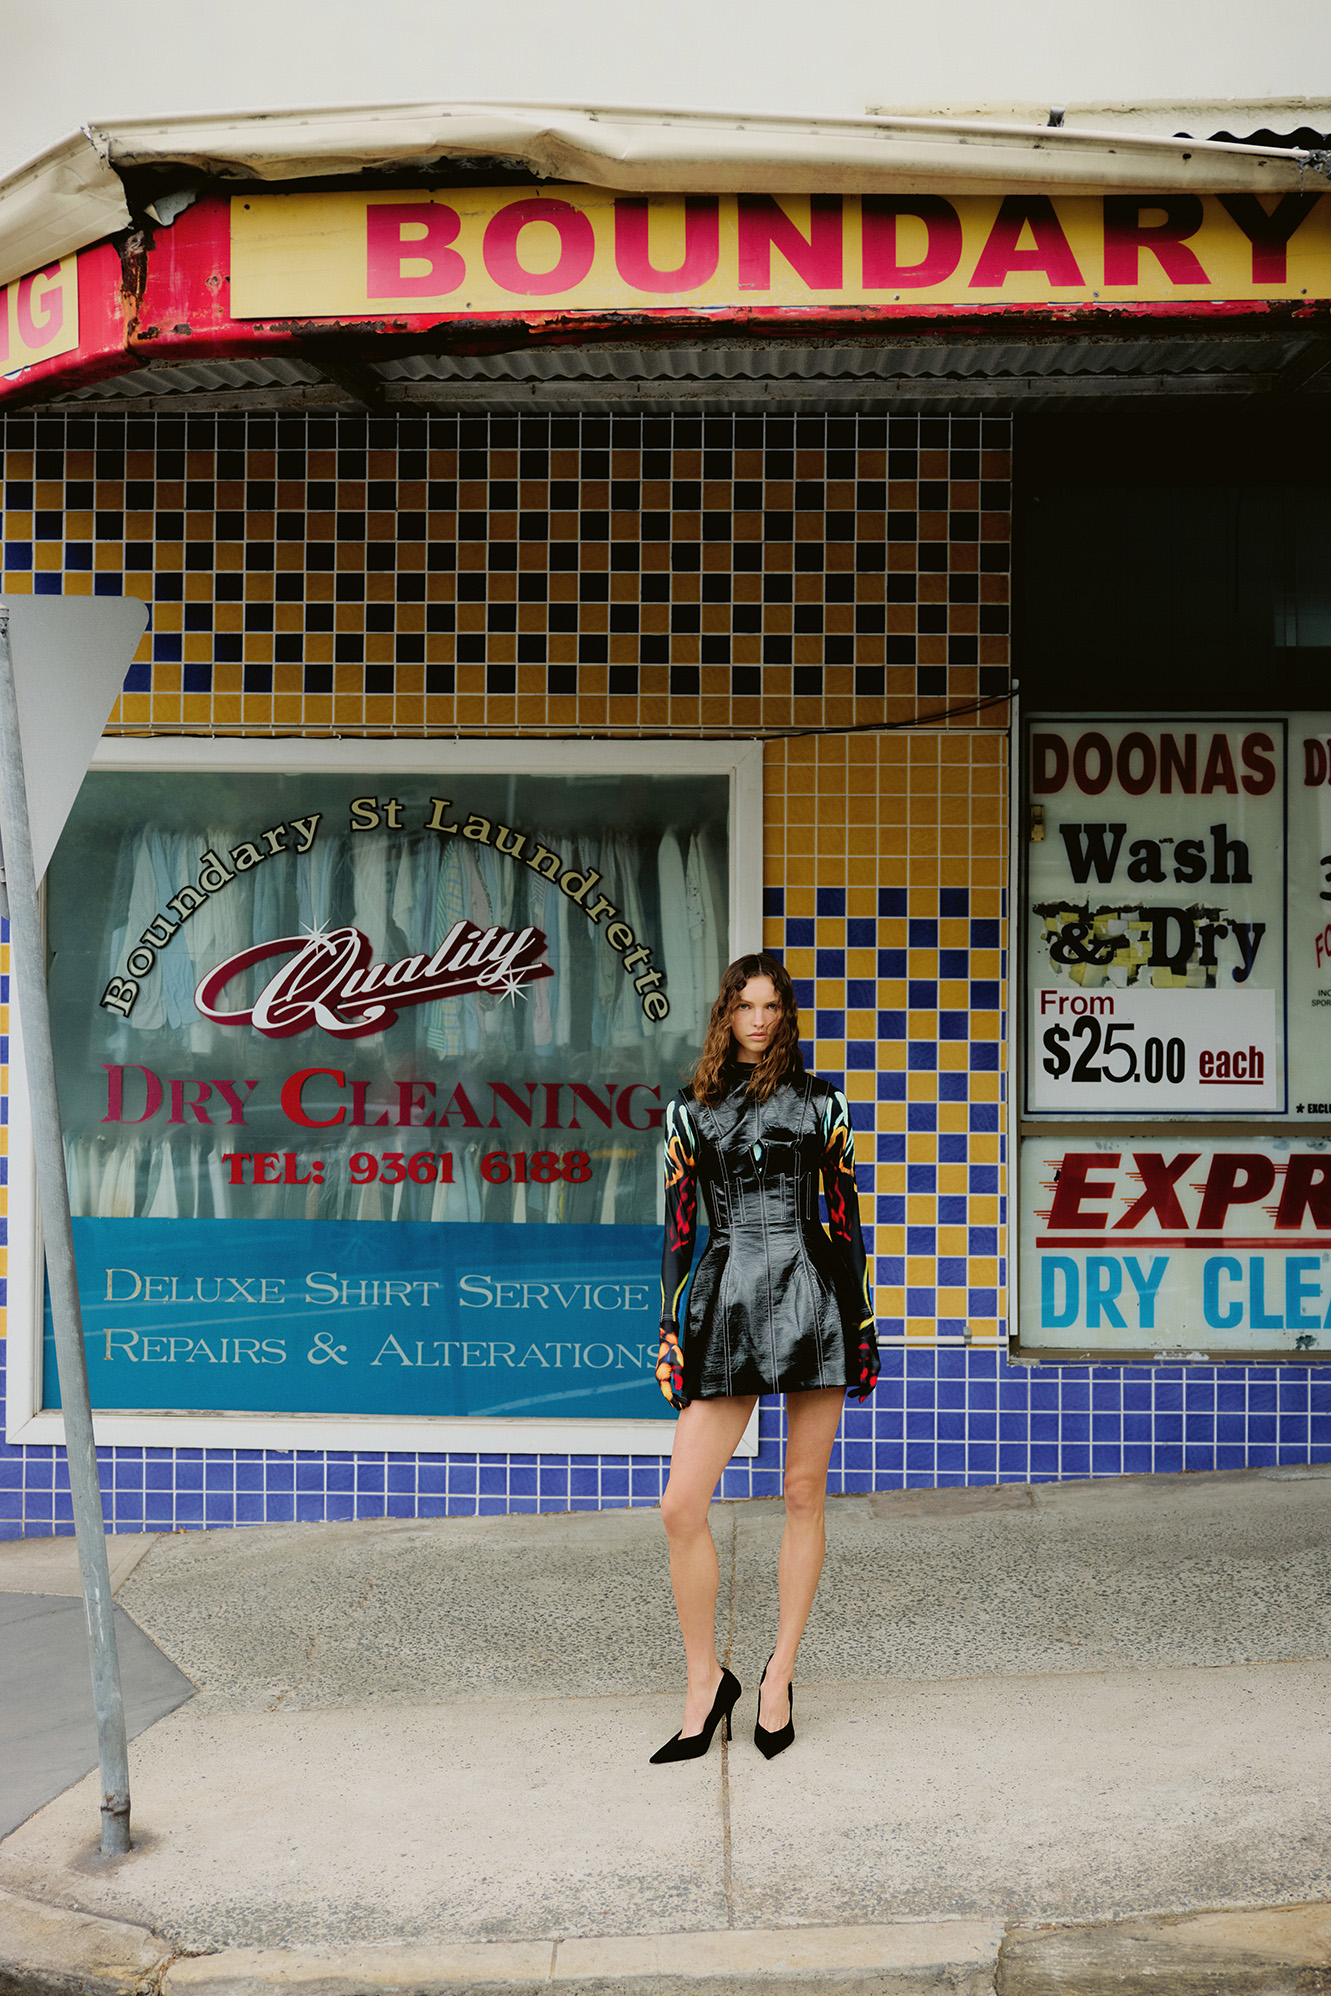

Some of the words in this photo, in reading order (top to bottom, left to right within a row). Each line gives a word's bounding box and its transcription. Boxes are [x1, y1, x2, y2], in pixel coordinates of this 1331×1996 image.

[366, 191, 1324, 298] BOUNDARY
[1033, 732, 1276, 796] DOONAS
[1059, 823, 1253, 884] Wash
[100, 812, 322, 1017] Boundary
[350, 796, 403, 831] St
[425, 796, 670, 1023] Laundrette
[1049, 922, 1117, 965] &
[1147, 907, 1266, 982] Dry
[194, 919, 553, 1038] Quality
[1040, 989, 1115, 1015] From
[1042, 1015, 1186, 1084] $25.00
[1199, 1045, 1264, 1080] each
[99, 1064, 259, 1125] DRY
[281, 1067, 666, 1130] CLEANING
[221, 1152, 324, 1184] TEL:
[349, 1151, 455, 1184] 9361
[480, 1151, 592, 1184] 6188
[103, 1268, 286, 1303] DELUXE
[305, 1271, 440, 1306] SHIRT
[459, 1274, 649, 1311] SERVICE
[1041, 1256, 1170, 1328] DRY
[1203, 1256, 1331, 1329] CLE
[103, 1328, 287, 1364] REPAIRS
[307, 1332, 349, 1365] &
